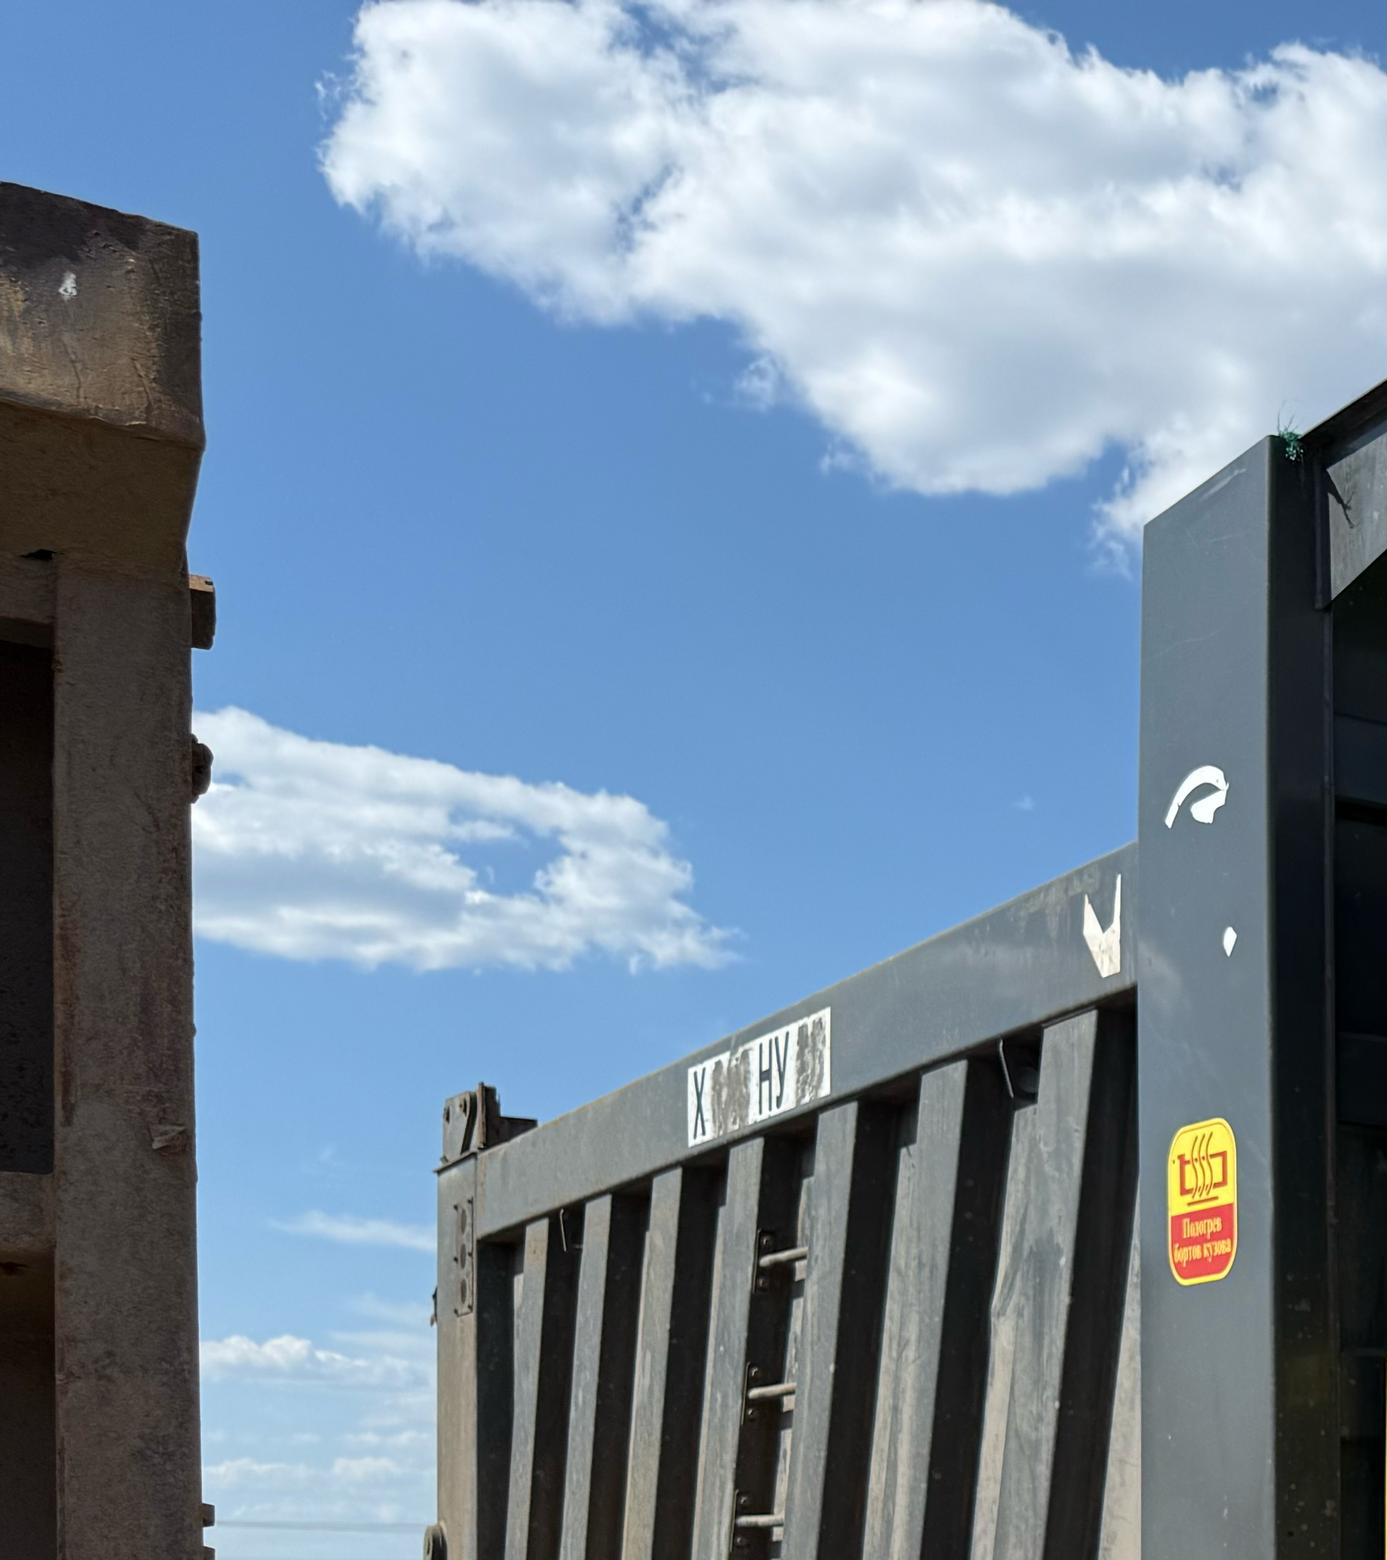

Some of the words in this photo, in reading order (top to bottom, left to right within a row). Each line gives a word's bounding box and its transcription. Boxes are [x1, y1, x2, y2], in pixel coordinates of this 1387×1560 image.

[1182, 1217, 1222, 1239] Подогрев
[1173, 1243, 1202, 1267] бортов
[1203, 1238, 1232, 1262] кузова
